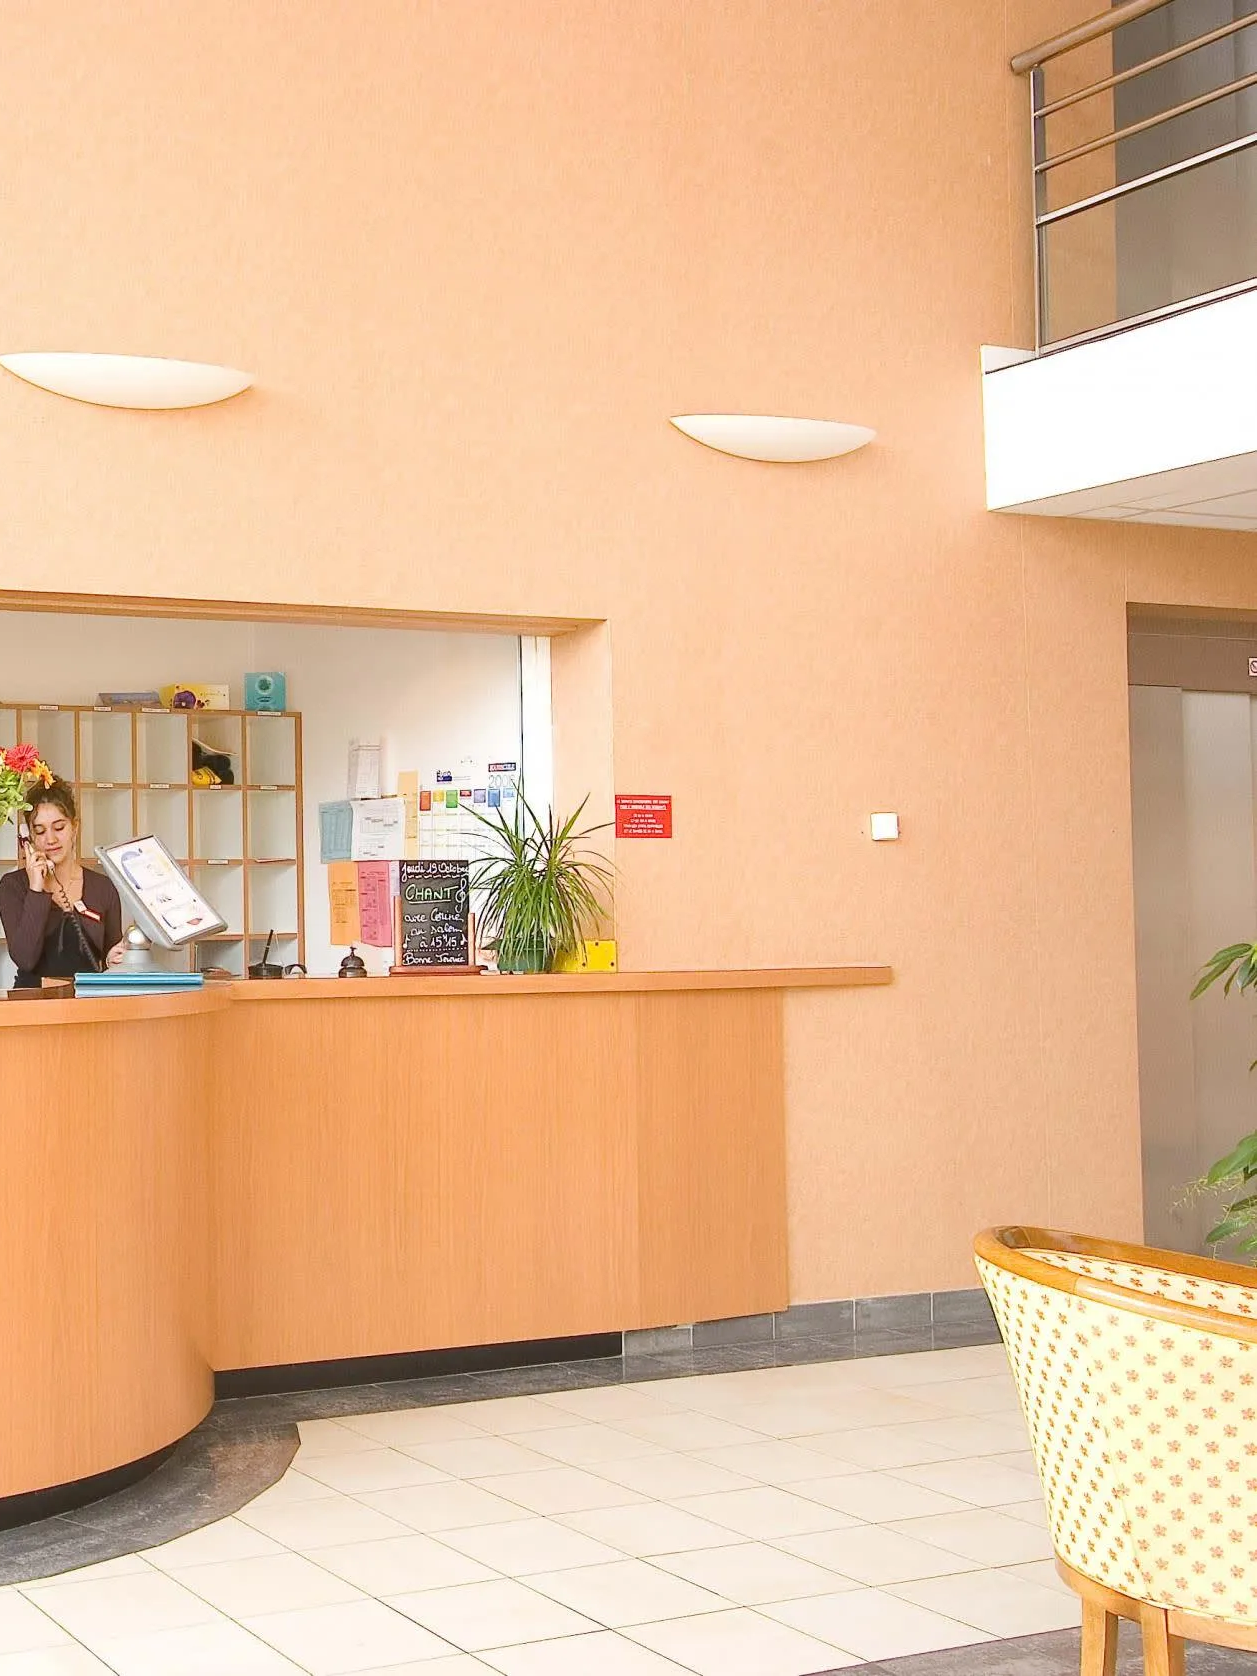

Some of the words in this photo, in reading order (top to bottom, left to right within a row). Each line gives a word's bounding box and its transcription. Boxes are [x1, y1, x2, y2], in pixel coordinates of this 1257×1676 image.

[405, 883, 459, 901] CHANT
[404, 914, 429, 923] avec
[410, 927, 427, 937] au
